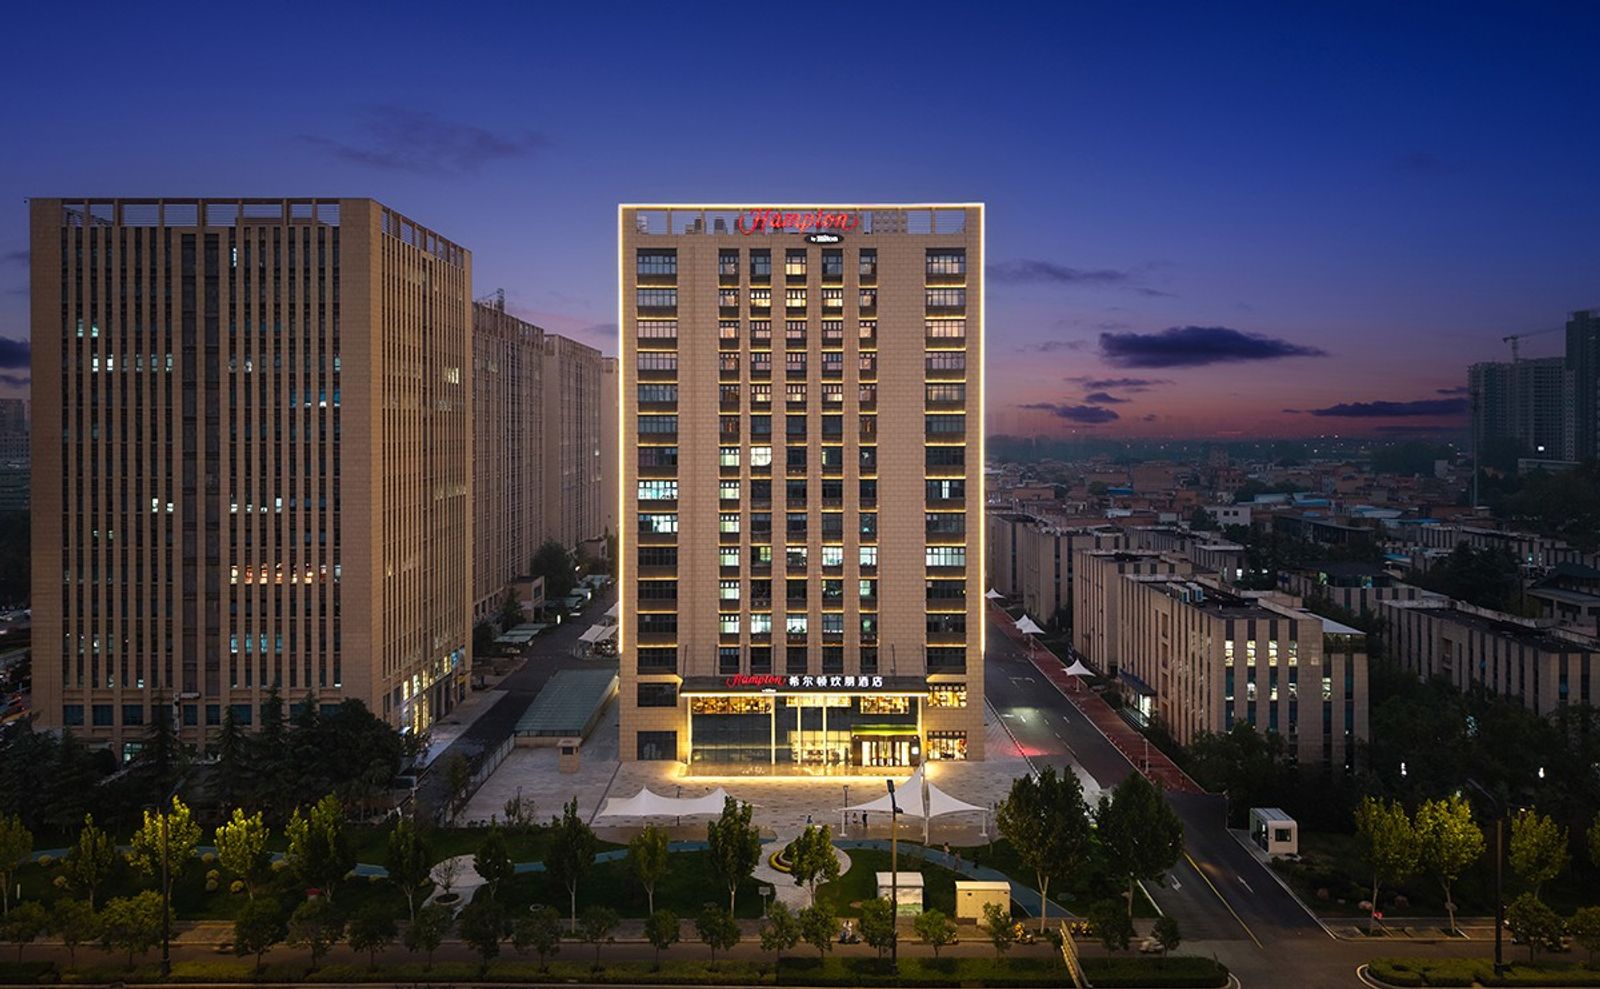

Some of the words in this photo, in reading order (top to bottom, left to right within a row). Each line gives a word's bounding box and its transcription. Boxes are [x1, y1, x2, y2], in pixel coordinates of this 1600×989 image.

[738, 208, 859, 236] Hampton
[726, 674, 786, 688] Hampton
[789, 676, 883, 687] 希尔顿欢朋酒店
